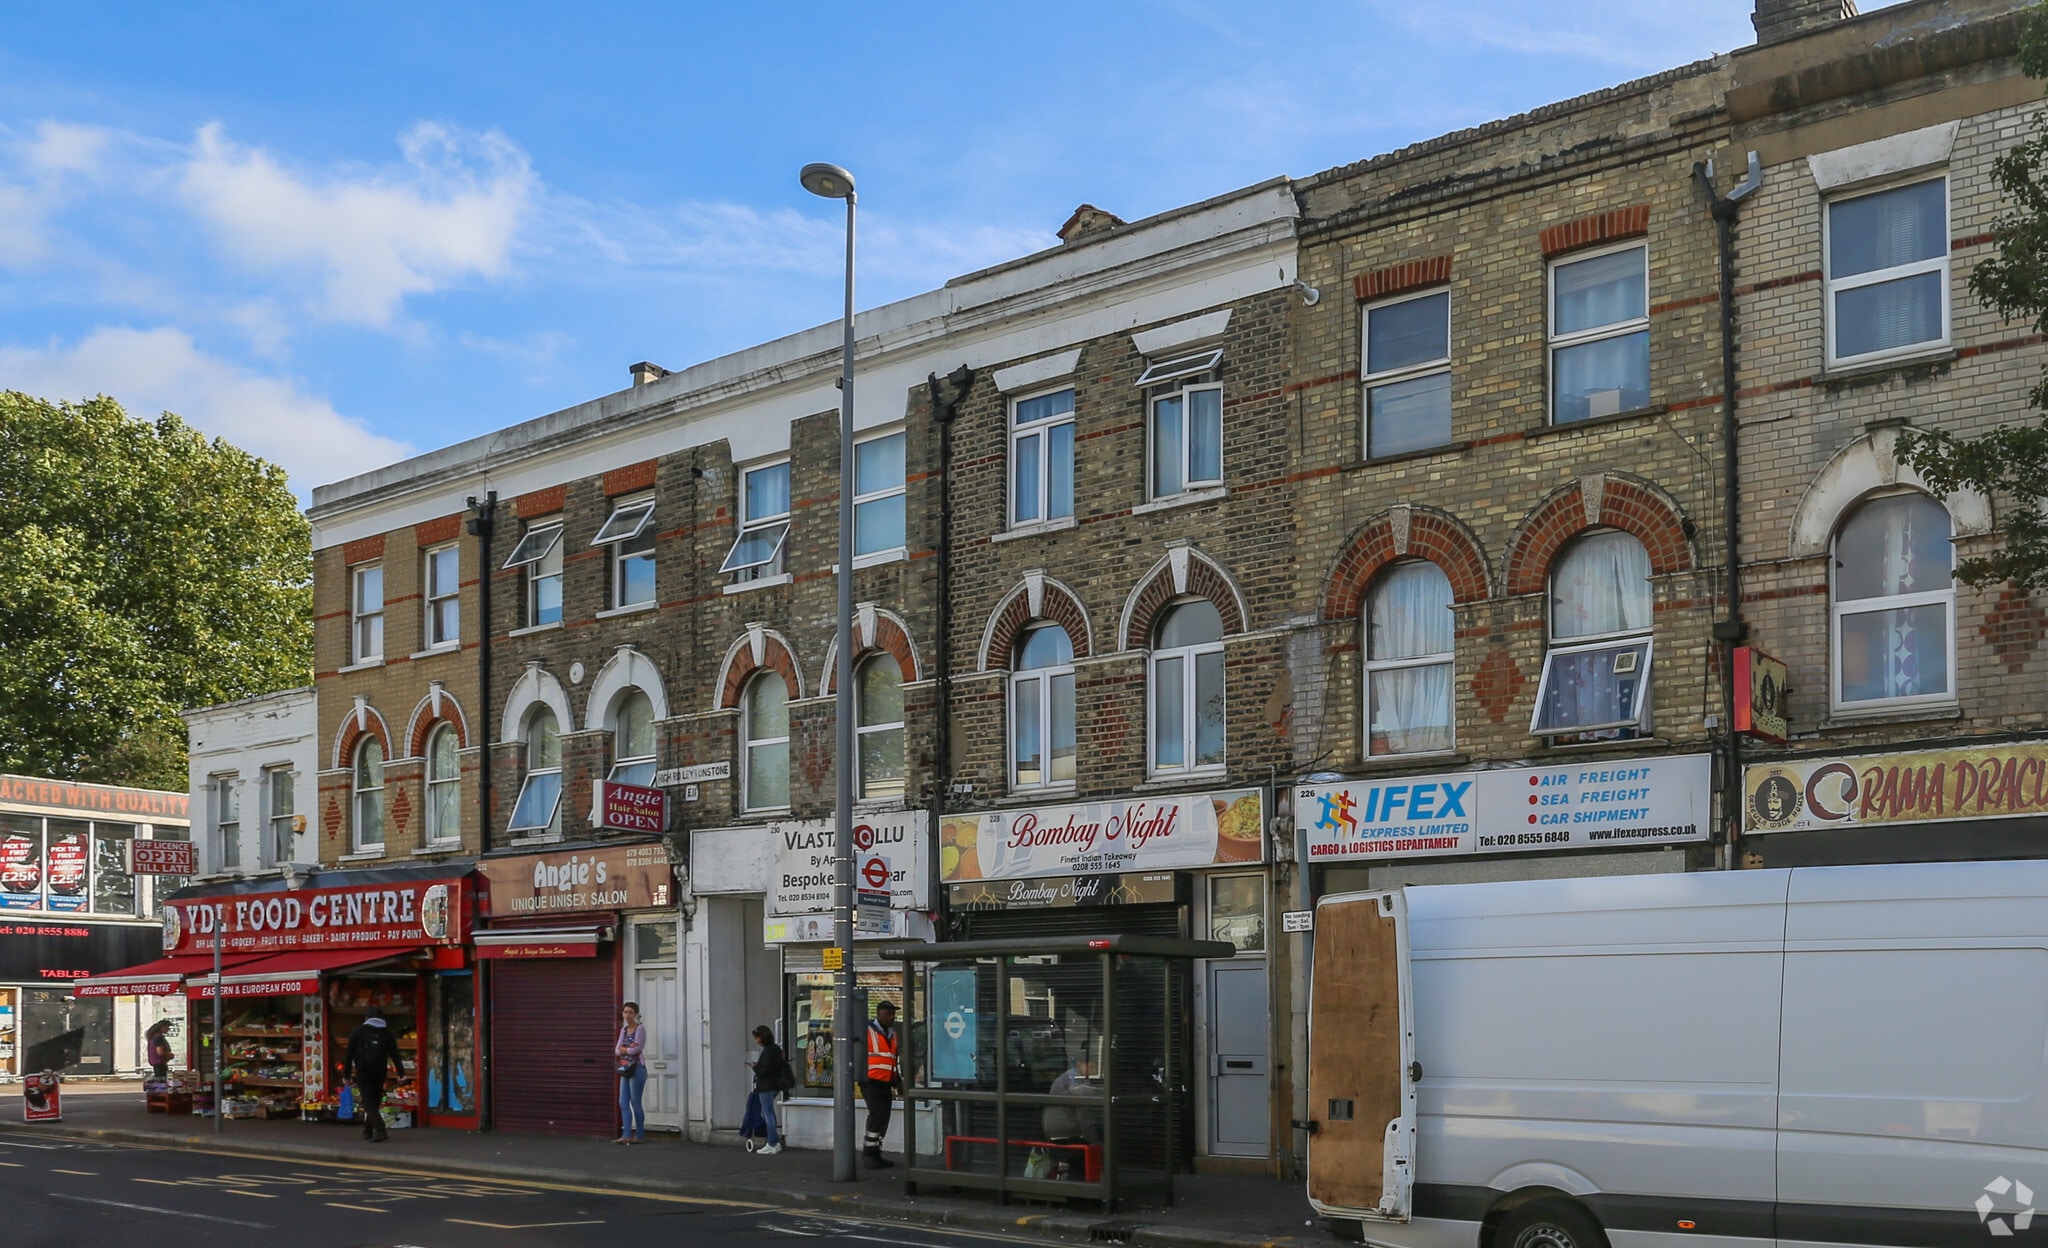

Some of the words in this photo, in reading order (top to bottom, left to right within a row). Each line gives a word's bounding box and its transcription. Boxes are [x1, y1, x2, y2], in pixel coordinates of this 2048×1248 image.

[658, 772, 672, 783] HIGH
[673, 772, 681, 781] RD
[682, 765, 728, 780] LEYTONSTONE
[1540, 774, 1568, 786] AIR
[1579, 768, 1650, 784] FREIGHT
[66, 787, 112, 809] WITH
[116, 793, 189, 816] QUALITY
[608, 786, 661, 807] Angie
[1364, 781, 1473, 823] IFEX
[1540, 794, 1569, 806] SEA
[1580, 788, 1650, 804] FREIGHT
[609, 803, 630, 813] Hair
[633, 806, 659, 816] Salon
[1540, 813, 1569, 825] CAR
[1573, 808, 1650, 823] SHIPMENT
[609, 812, 658, 829] OPEN
[1008, 813, 1099, 852] Bombay
[1106, 803, 1179, 849] Night
[784, 831, 835, 850] VLAST
[875, 826, 904, 844] LLU
[859, 829, 871, 846] Q
[1361, 826, 1415, 839] EXPRESS
[1419, 824, 1469, 836] LIMITED
[1480, 835, 1496, 846] Tel:
[1497, 834, 1516, 845] 020
[1517, 833, 1542, 844] 8555
[1544, 832, 1569, 843] 6848
[1589, 823, 1696, 840] www.ifexexpress.co.uk
[154, 842, 189, 850] LICENCE
[1311, 844, 1339, 856] CARGO
[1341, 845, 1347, 853] &
[1349, 840, 1394, 853] LOGISTICS
[1396, 837, 1459, 850] DEPARTAMENT
[136, 850, 188, 864] OPEN
[811, 856, 821, 868] By
[1104, 853, 1137, 861] Takeaway
[136, 864, 159, 872] TILL
[163, 865, 190, 873] LATE
[534, 855, 606, 891] Angie's
[1072, 862, 1088, 871] 0208
[1090, 862, 1102, 870] 555
[1105, 861, 1120, 869] 1645
[2, 871, 37, 881] £25K
[783, 872, 834, 890] Bespoke
[1007, 880, 1058, 904] Bombay
[1061, 877, 1100, 903] Night
[512, 896, 547, 910] UNIQUE
[550, 893, 586, 908] UNISEX
[591, 890, 627, 905] SALON
[186, 904, 227, 934] YDL
[236, 898, 301, 931] FOOD
[310, 889, 415, 927] CENTRE
[16, 926, 35, 935] 020
[37, 927, 62, 936] 8555
[64, 928, 89, 936] 8886
[196, 940, 205, 948] OFF
[206, 938, 226, 948] LICCE
[232, 938, 255, 946] GROCERY
[262, 936, 277, 945] FRUIT
[285, 935, 296, 943] VEG
[302, 934, 324, 943] BAKERY
[331, 933, 350, 942] DAIRY
[352, 931, 381, 941] PRODUCT
[388, 930, 400, 940] PAY
[402, 929, 422, 939] POINT
[767, 923, 785, 940] 230
[40, 969, 89, 978] TABLES
[34, 992, 49, 1000] 238
[80, 984, 109, 994] WELCOME
[111, 985, 118, 994] TO
[119, 985, 129, 993] YDL
[131, 984, 146, 993] FOOD
[147, 983, 170, 992] CENTRE
[202, 987, 233, 996] EASERN
[242, 984, 280, 994] EUROPEAN
[281, 982, 301, 991] FOOD
[305, 1184, 544, 1202] BUS
